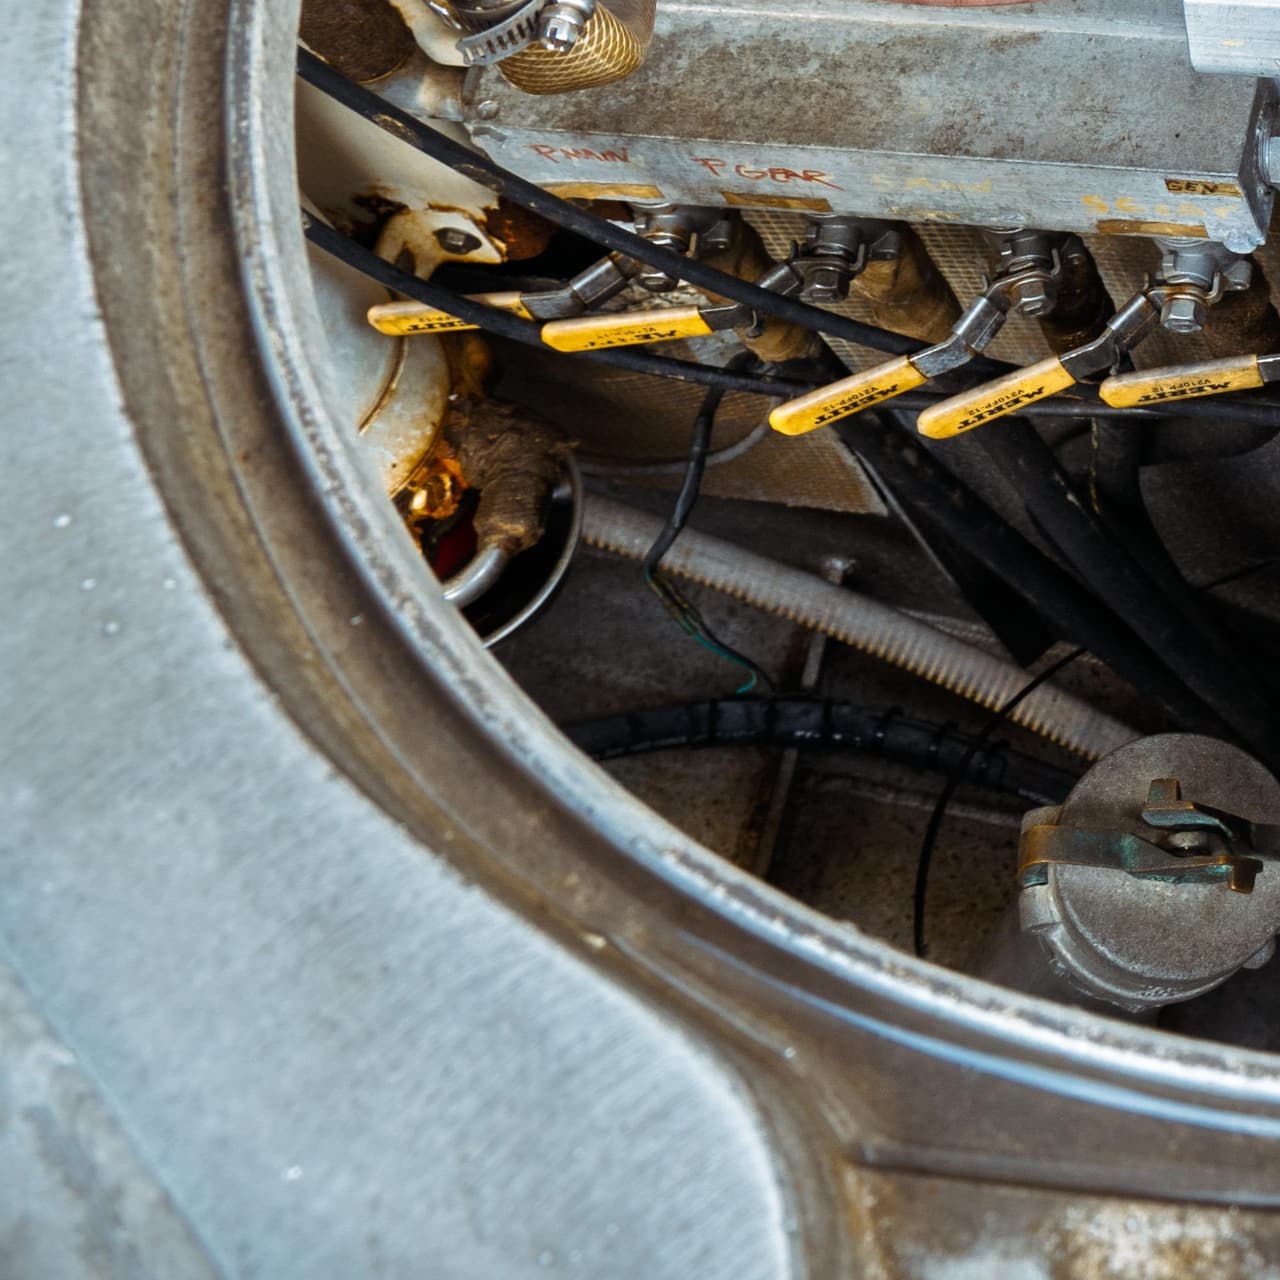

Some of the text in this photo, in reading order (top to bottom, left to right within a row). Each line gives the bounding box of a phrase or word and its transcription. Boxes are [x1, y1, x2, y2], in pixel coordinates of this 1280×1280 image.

[1165, 179, 1219, 196] GEN
[814, 384, 898, 425] MERIT
[823, 387, 879, 412] V210FP-12
[967, 389, 1025, 416] V210FP-12
[1137, 381, 1231, 403] MERIT
[957, 386, 1045, 430] MERIT
